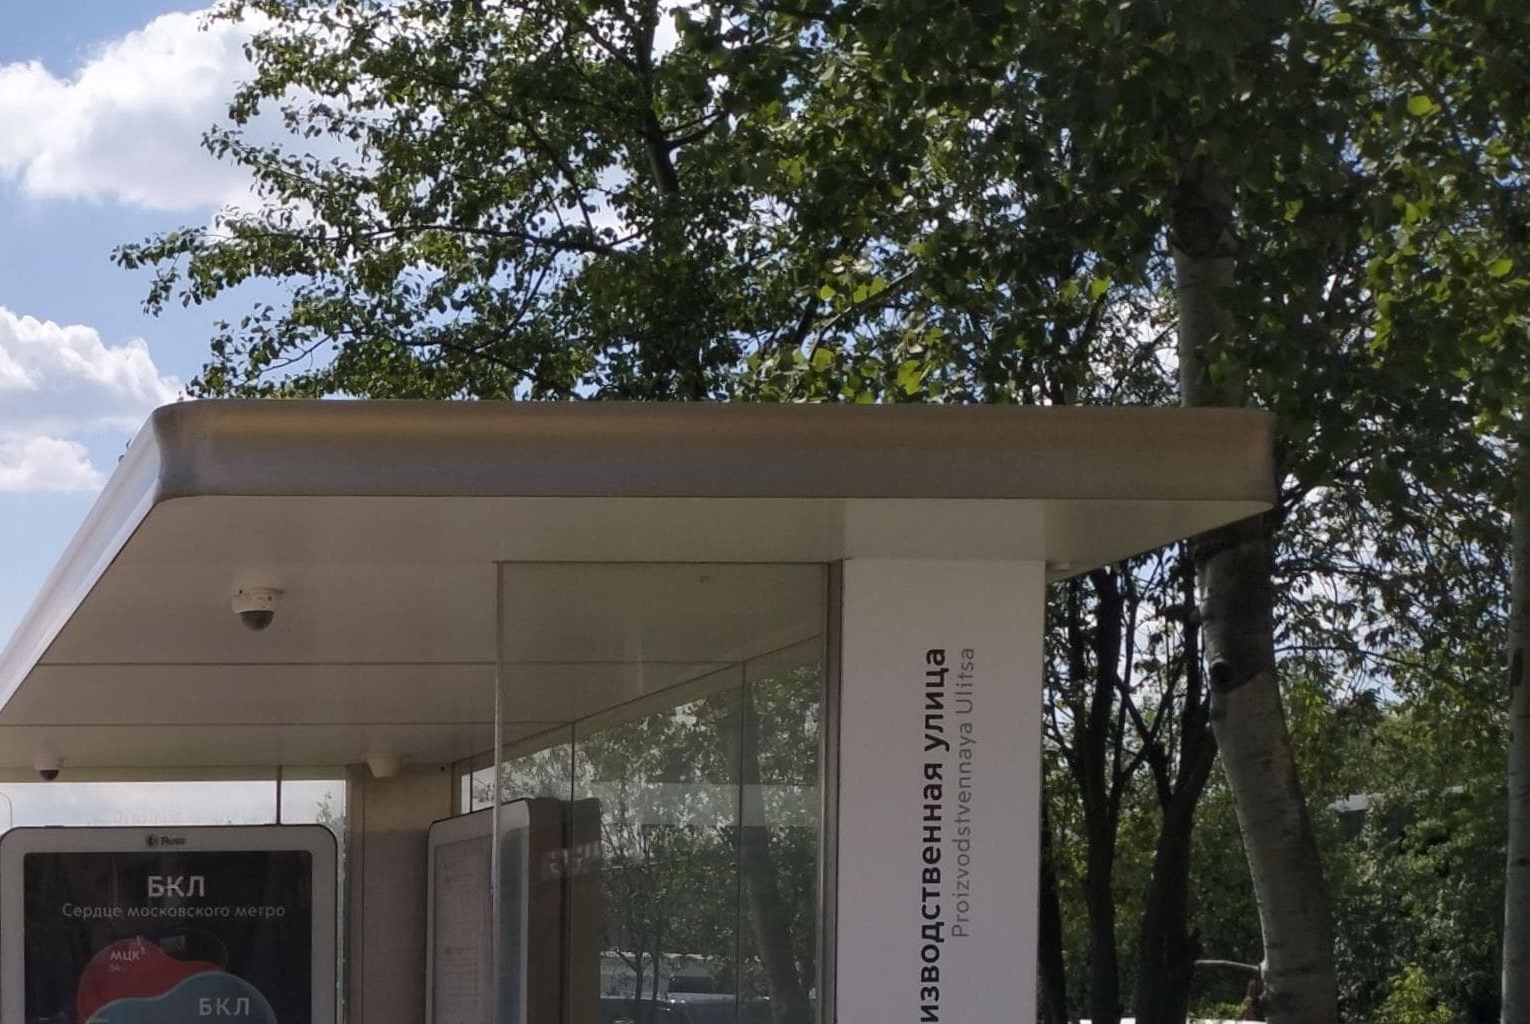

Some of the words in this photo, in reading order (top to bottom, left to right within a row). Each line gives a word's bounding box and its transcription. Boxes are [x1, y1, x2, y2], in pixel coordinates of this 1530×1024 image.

[924, 648, 950, 752] улица
[955, 648, 975, 714] Ulitsa
[951, 722, 977, 938] Proizvodstvennaya
[147, 875, 206, 898] БКЛ
[62, 903, 120, 920] Сердце
[127, 904, 231, 918] московского
[234, 904, 286, 919] метро
[198, 998, 250, 1016] БКЛ
